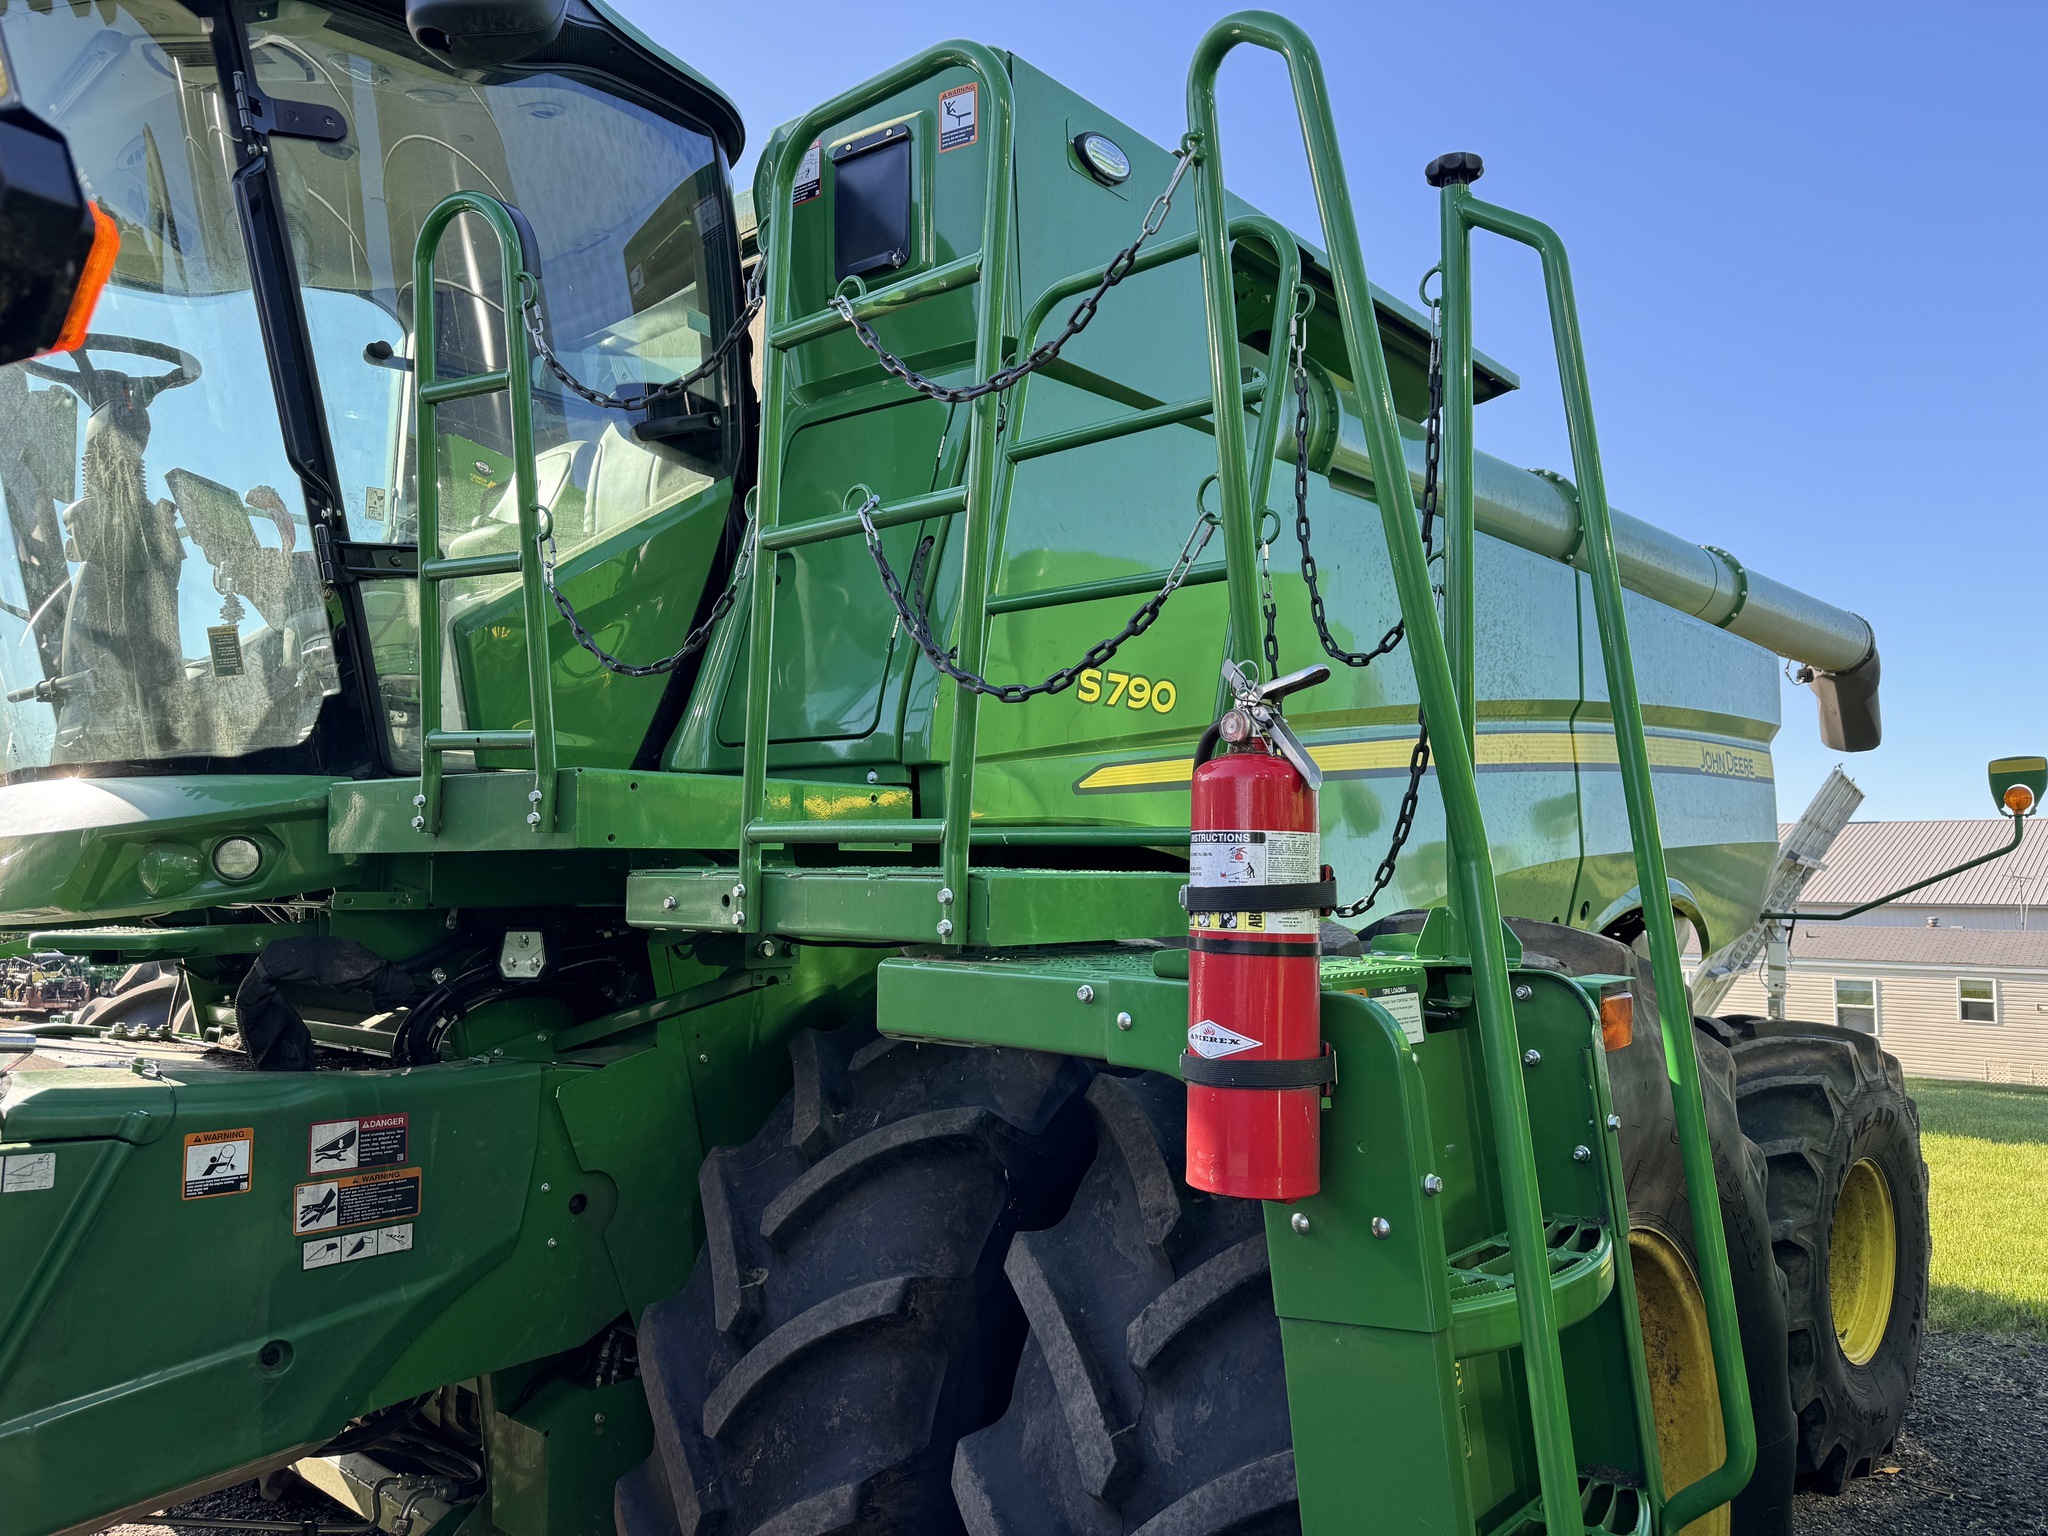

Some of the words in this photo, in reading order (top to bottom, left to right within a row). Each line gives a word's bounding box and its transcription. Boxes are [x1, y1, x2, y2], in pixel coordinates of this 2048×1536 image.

[948, 84, 975, 97] WARNING
[1076, 668, 1177, 714] S790
[1700, 746, 1725, 772] JOHN
[1726, 751, 1755, 776] DEERE
[1191, 833, 1250, 843] NSTRUCTIONS
[1248, 912, 1262, 928] AB
[1190, 1033, 1241, 1045] AMEREX
[370, 1117, 404, 1128] DANGER
[203, 1130, 245, 1142] WARNING
[362, 1171, 400, 1183] WARNING
